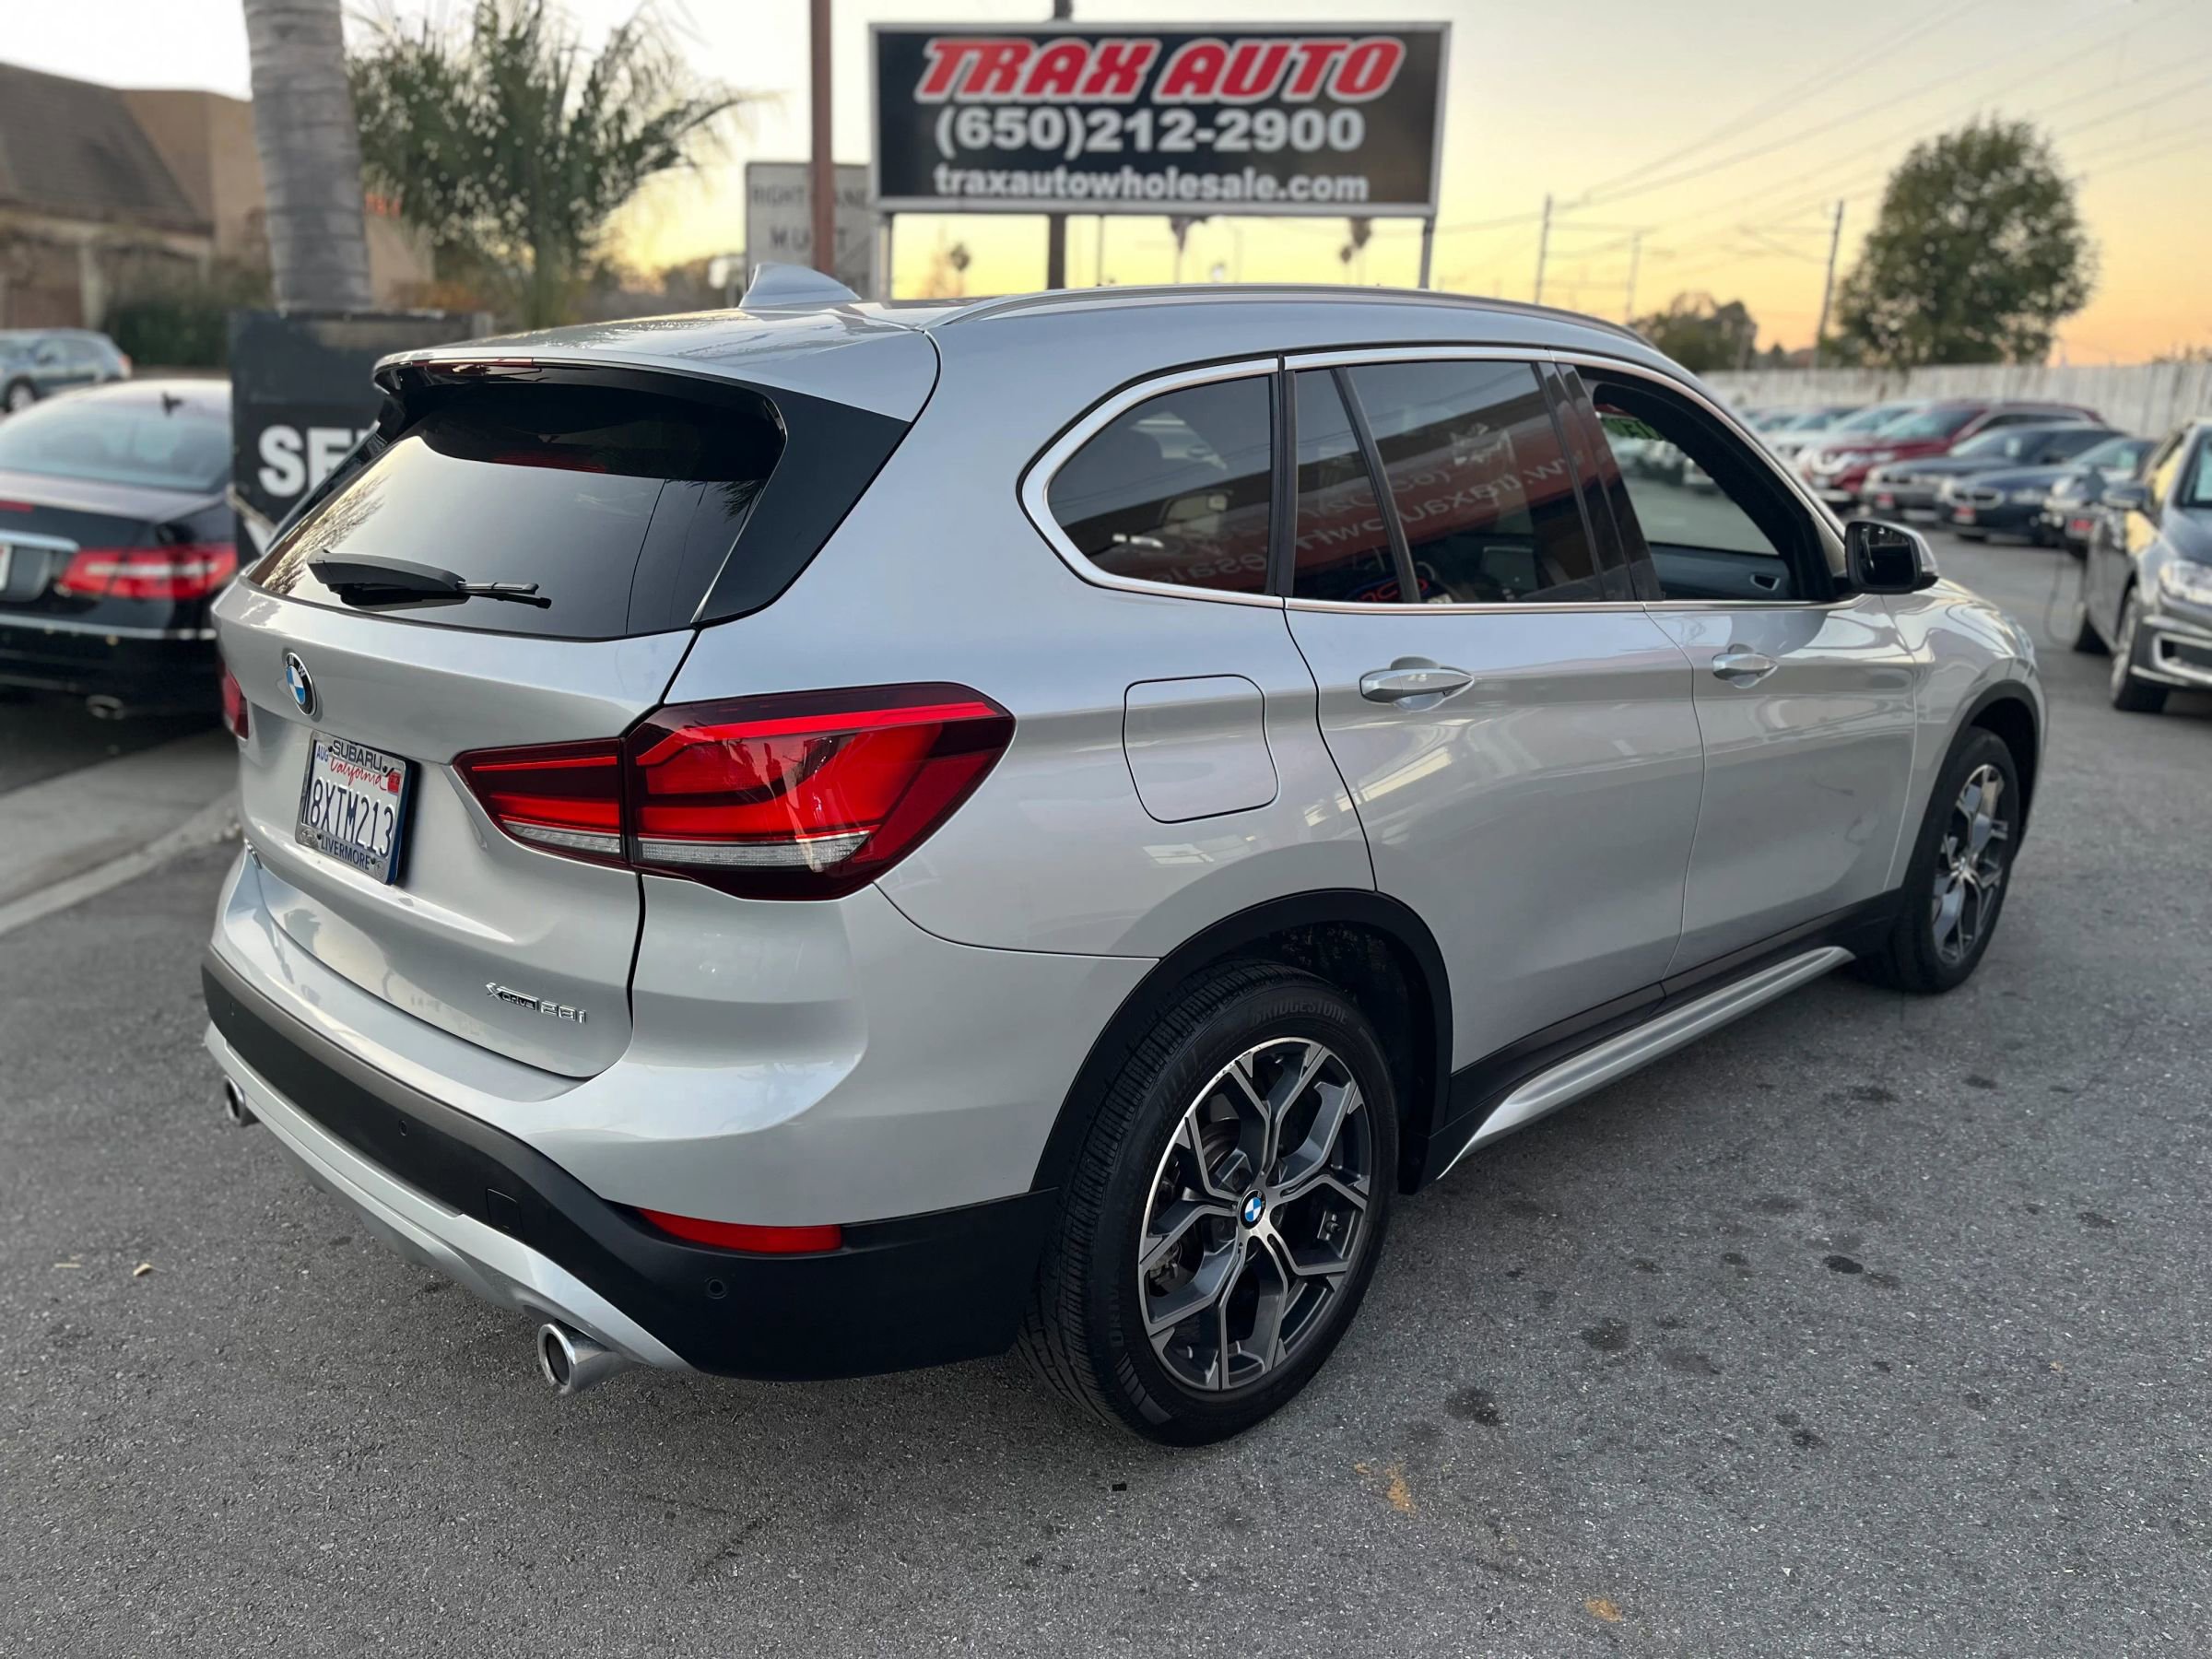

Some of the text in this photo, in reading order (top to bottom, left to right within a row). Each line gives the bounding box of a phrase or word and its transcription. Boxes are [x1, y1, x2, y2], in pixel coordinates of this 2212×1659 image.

[913, 37, 1406, 104] TRAX AUTO
[935, 106, 1366, 160] (650)212-2900
[933, 163, 1370, 201] traxautowholesale.com
[770, 228, 847, 252] MUT
[259, 425, 371, 496] SE
[316, 745, 329, 762] AUG
[333, 740, 382, 771] SUBARU
[311, 779, 394, 856] 8XTM213
[320, 834, 371, 870] LIVERMORE
[540, 1001, 587, 1024] 28i
